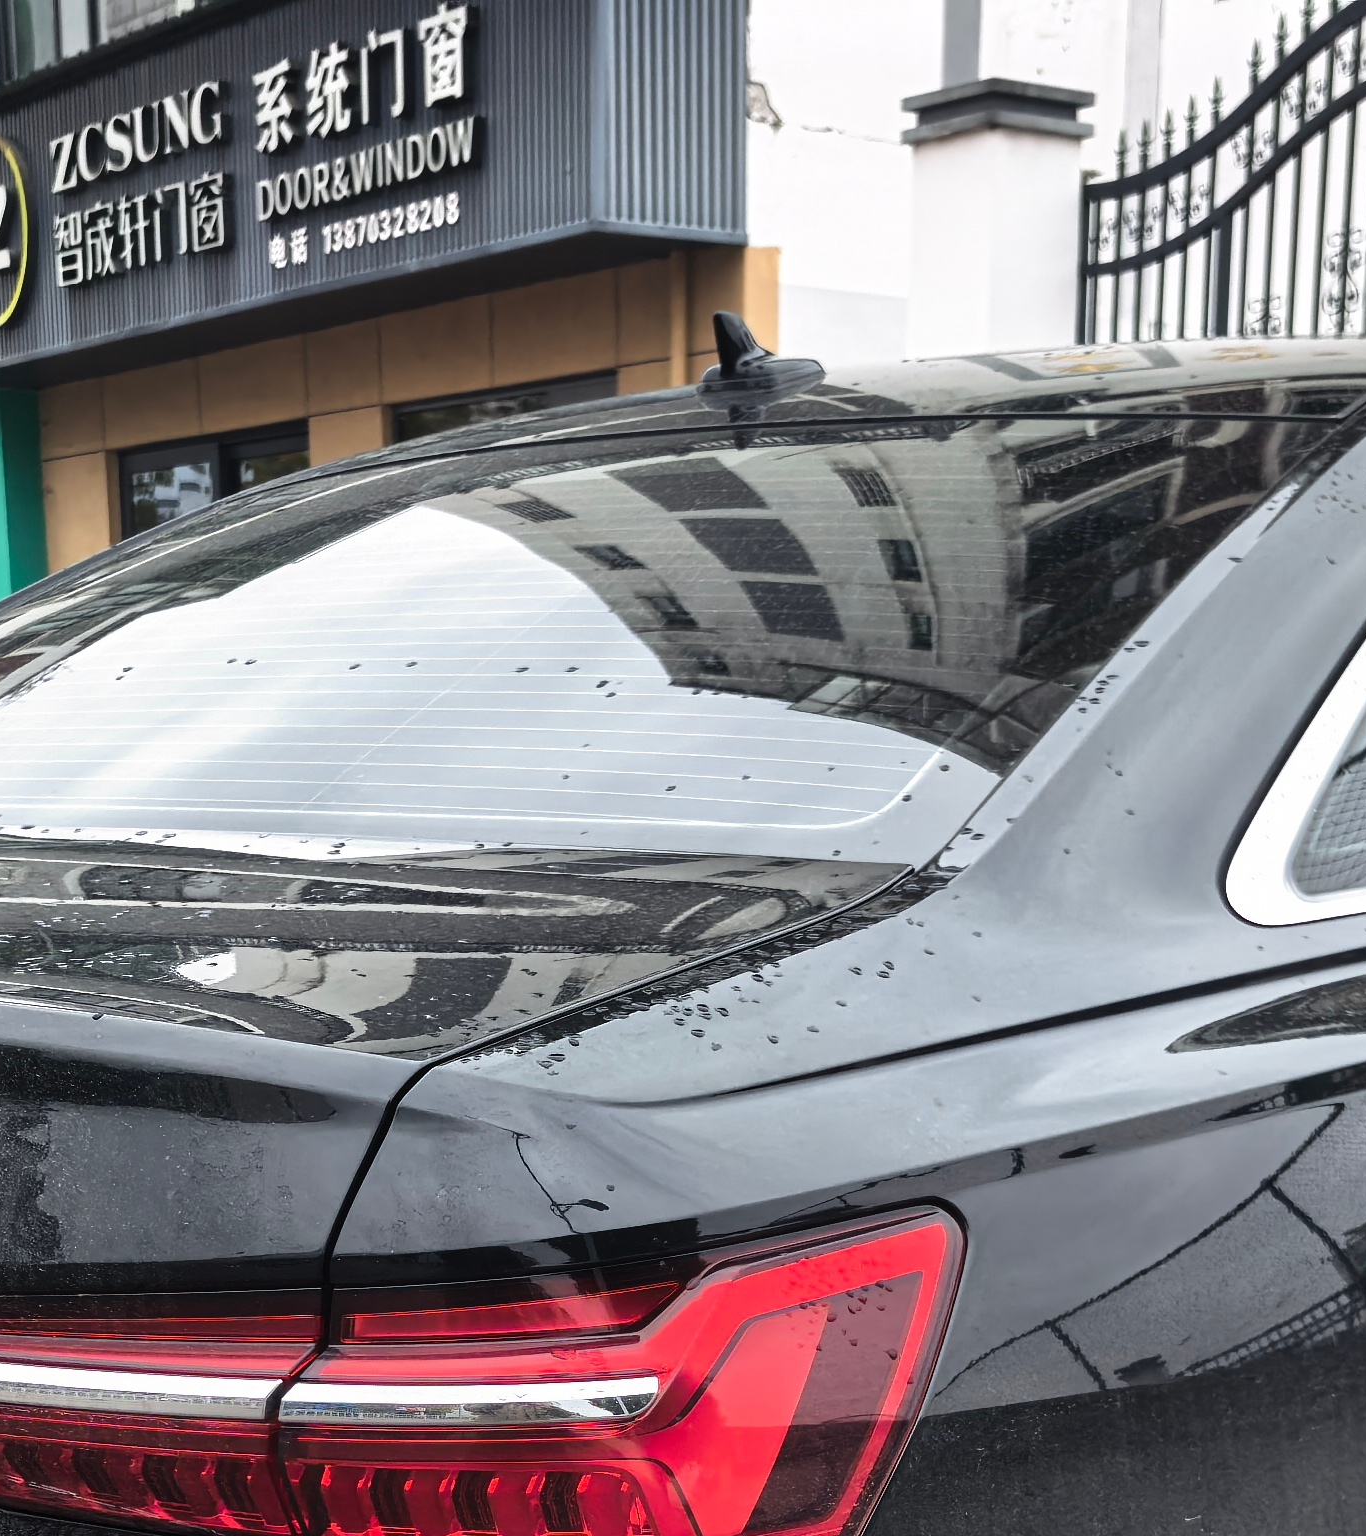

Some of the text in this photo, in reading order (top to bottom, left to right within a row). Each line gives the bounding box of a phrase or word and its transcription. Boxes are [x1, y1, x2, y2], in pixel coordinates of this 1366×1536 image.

[251, 3, 468, 153] 系统门窗
[49, 81, 223, 194] ZCSUNG
[256, 116, 475, 222] DOOR&WINDOW
